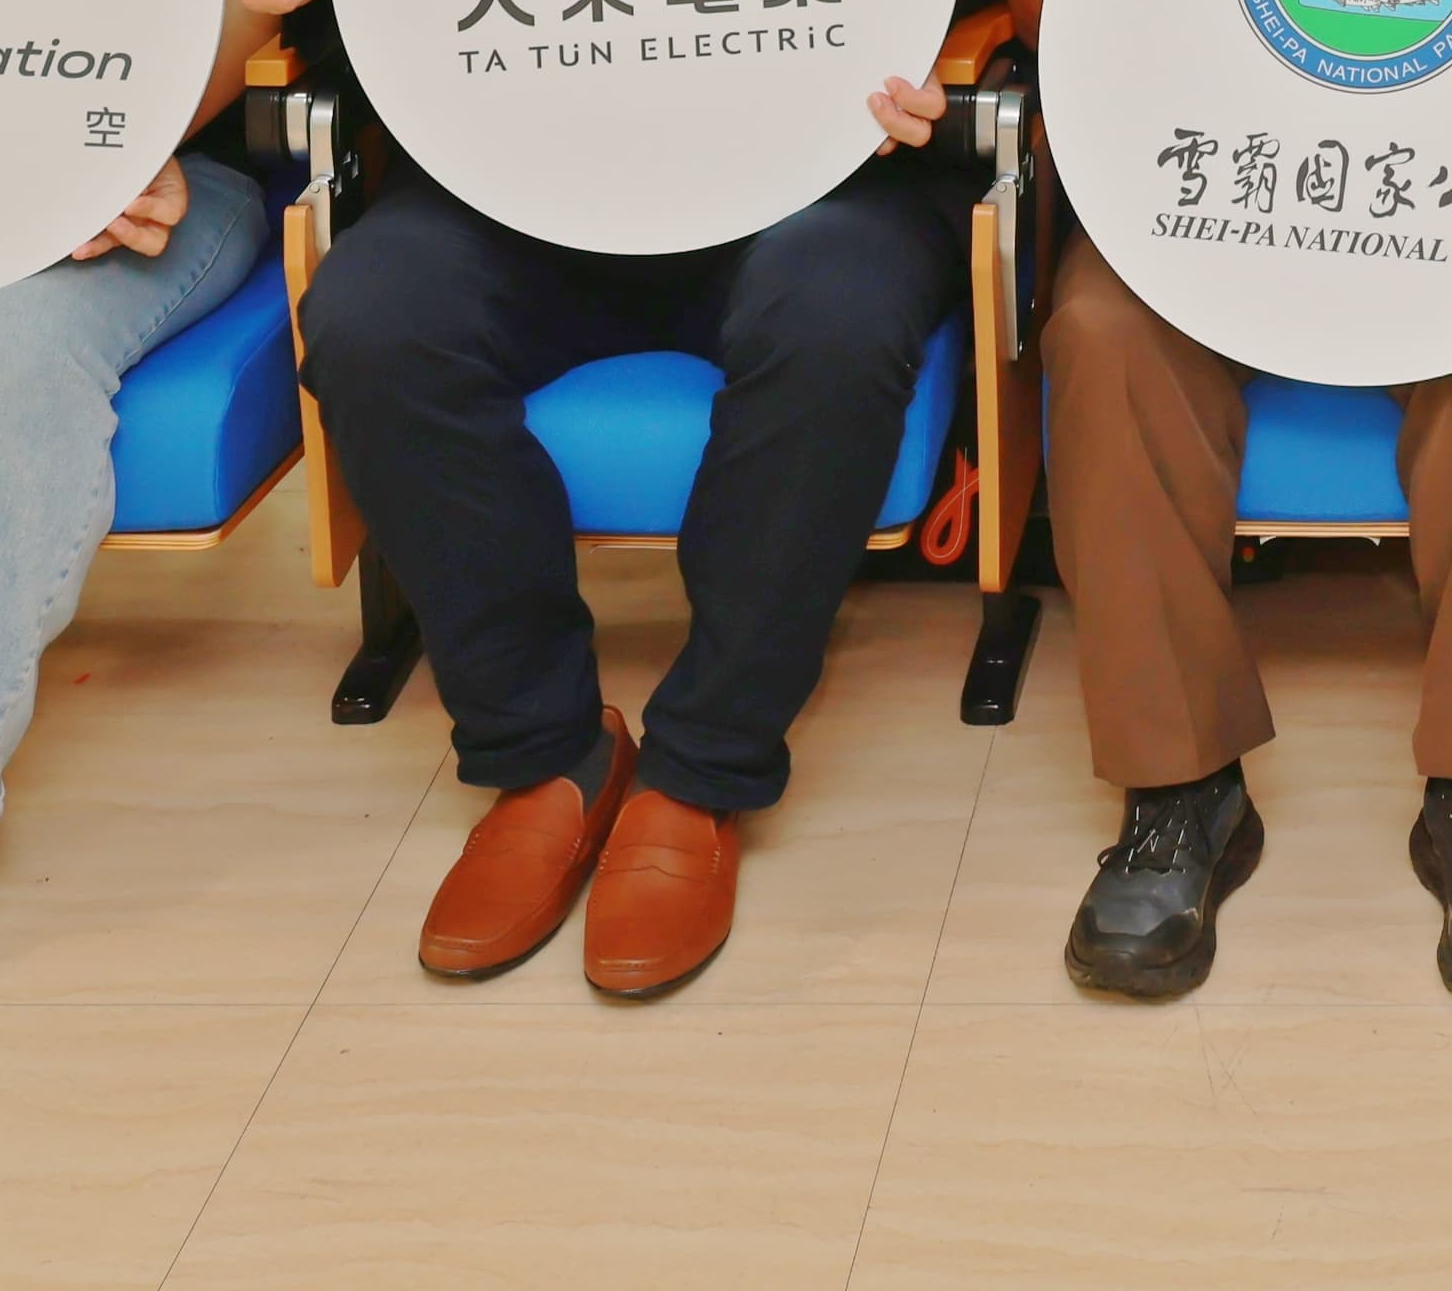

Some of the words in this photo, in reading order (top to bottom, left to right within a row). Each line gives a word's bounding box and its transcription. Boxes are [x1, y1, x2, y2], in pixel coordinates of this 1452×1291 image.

[458, 49, 508, 75] TA
[1317, 57, 1428, 84] NATIONAL
[1151, 212, 1277, 248] SHEI-PA
[1283, 225, 1448, 264] NATIONAL
